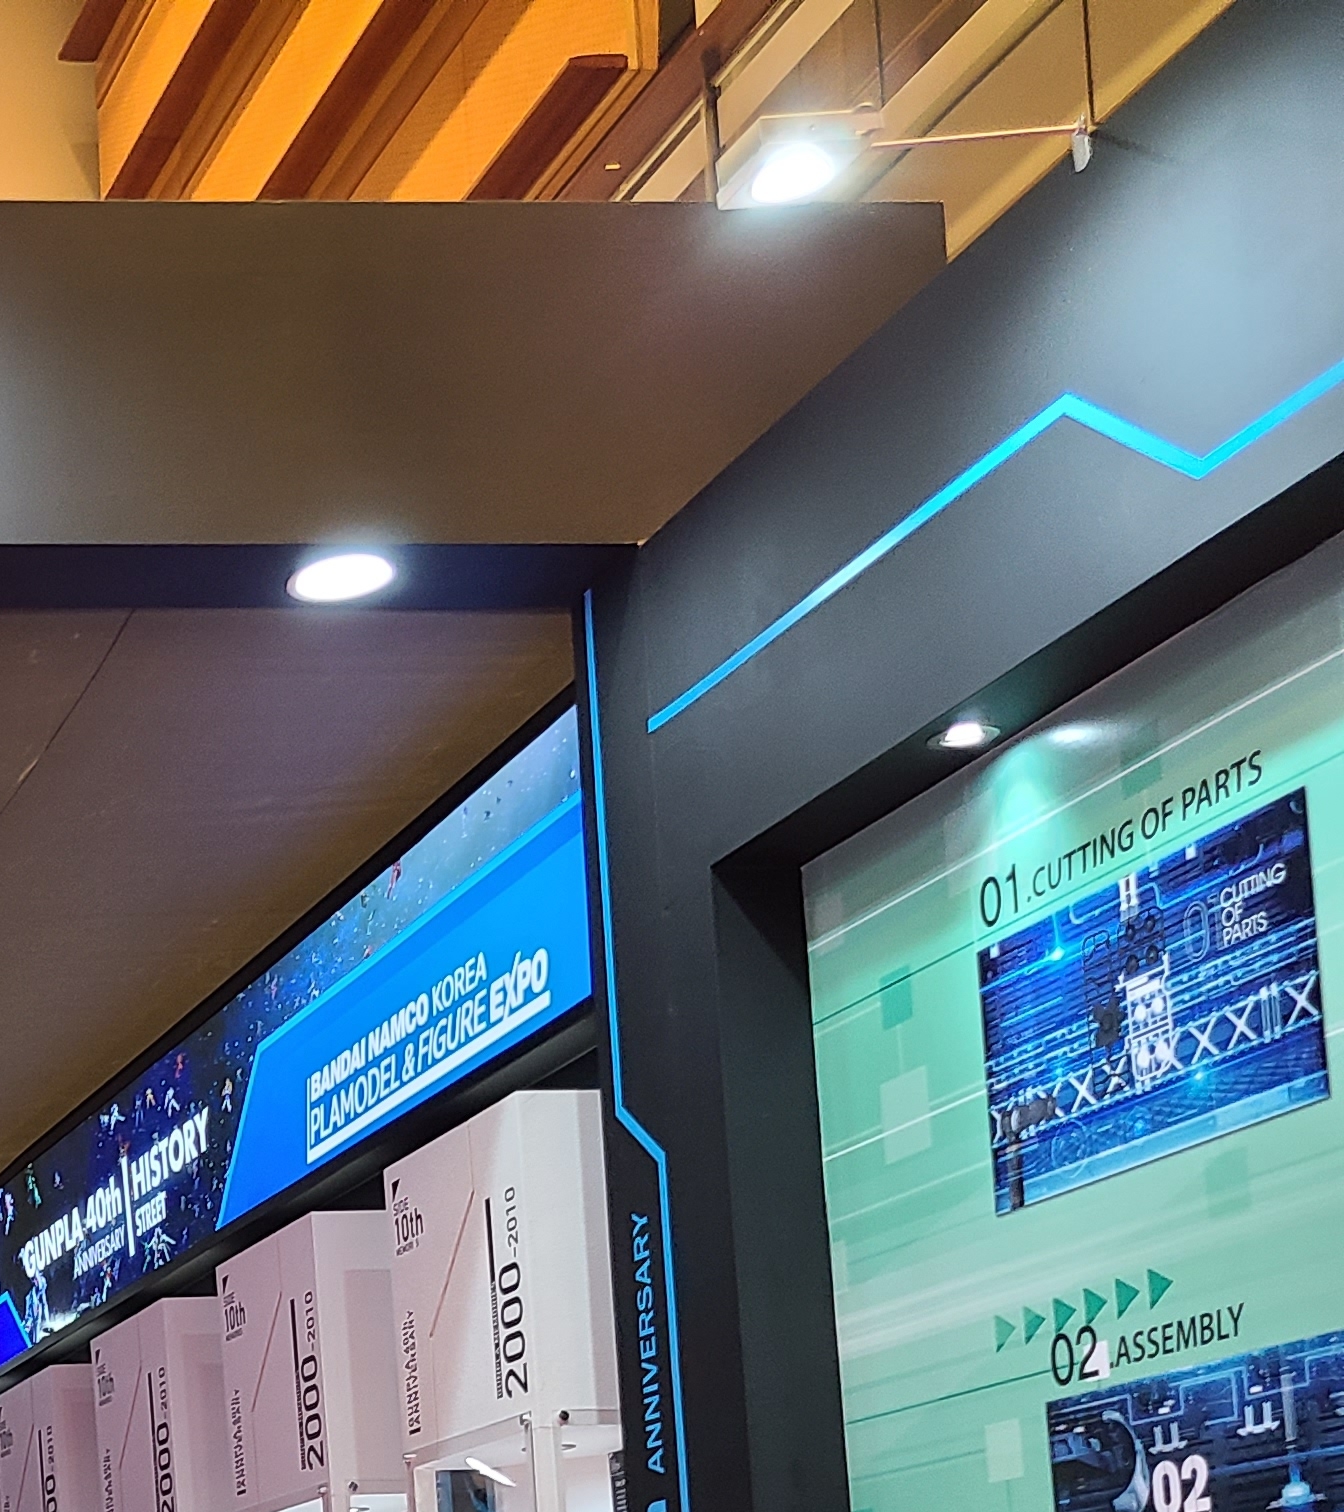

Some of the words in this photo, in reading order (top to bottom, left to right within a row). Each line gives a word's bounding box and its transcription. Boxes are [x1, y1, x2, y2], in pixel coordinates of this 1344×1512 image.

[1140, 796, 1174, 841] OF
[1181, 749, 1264, 822] PARTS
[1220, 863, 1287, 907] CUTTING
[1222, 902, 1243, 927] OF
[1223, 911, 1267, 948] PARTS
[310, 1054, 400, 1145] PLAMODEL
[402, 1043, 415, 1083] &
[417, 988, 488, 1073] FIGURE
[489, 947, 549, 1024] EXPO
[311, 1037, 367, 1103] BANDAI
[368, 992, 429, 1062] NAMCO
[432, 951, 487, 1017] KOREA
[130, 1105, 210, 1201] HISTORY
[22, 1206, 84, 1279] GUNPLA
[86, 1175, 123, 1234] 40th
[135, 1190, 167, 1238] STREET
[394, 1206, 424, 1246] 10th
[73, 1224, 125, 1281] ANNIVERSARY
[224, 1300, 247, 1334] 10th
[630, 1210, 664, 1476] ANNIVERSARY
